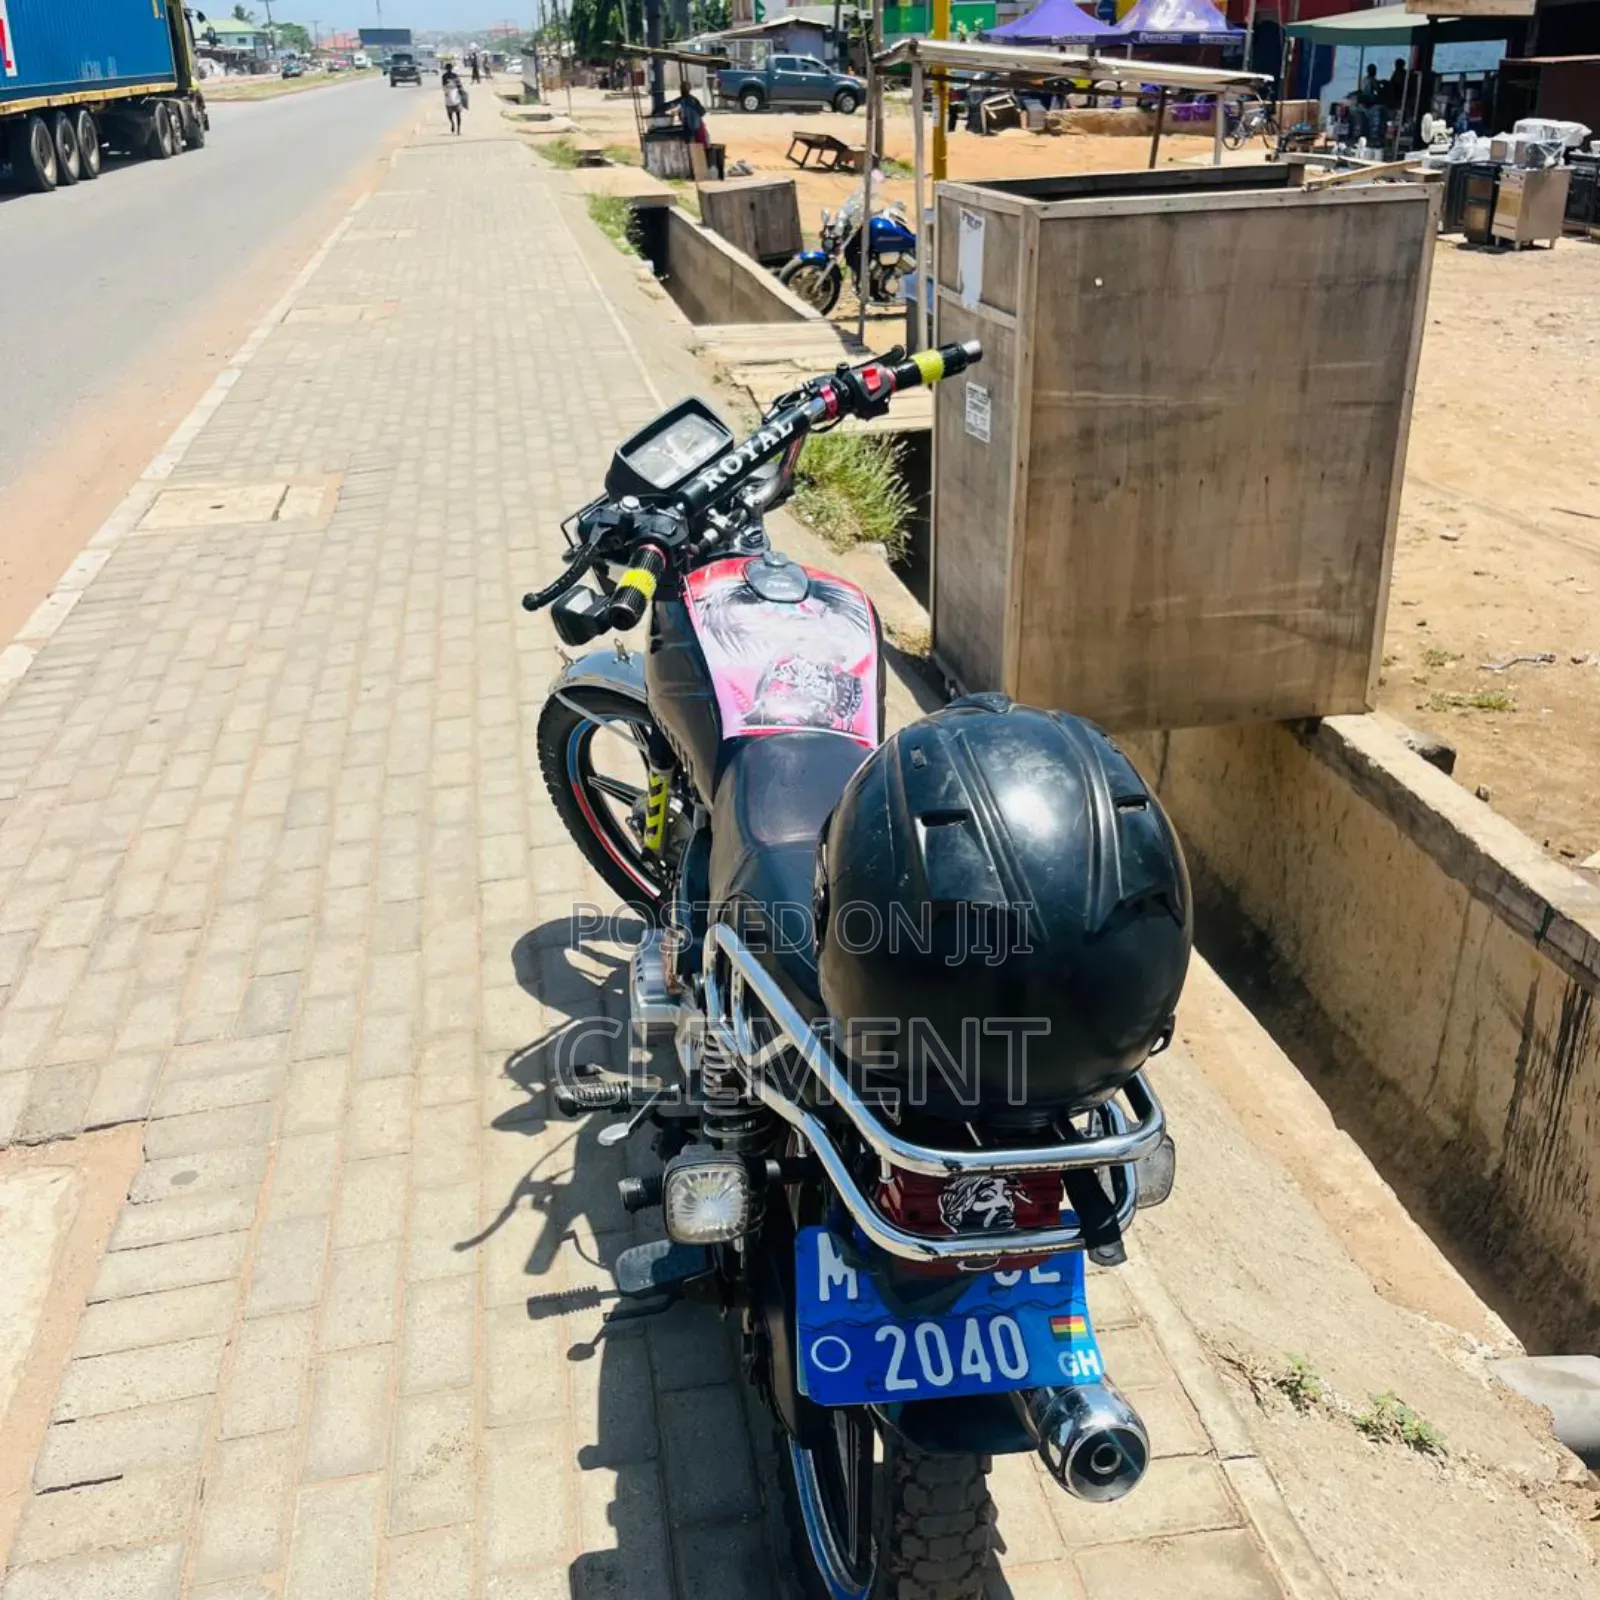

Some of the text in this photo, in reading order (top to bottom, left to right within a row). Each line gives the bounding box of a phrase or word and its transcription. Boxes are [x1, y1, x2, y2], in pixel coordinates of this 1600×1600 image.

[697, 420, 794, 492] ROYAL
[874, 1315, 1029, 1391] 2040
[1057, 1350, 1101, 1377] GH
